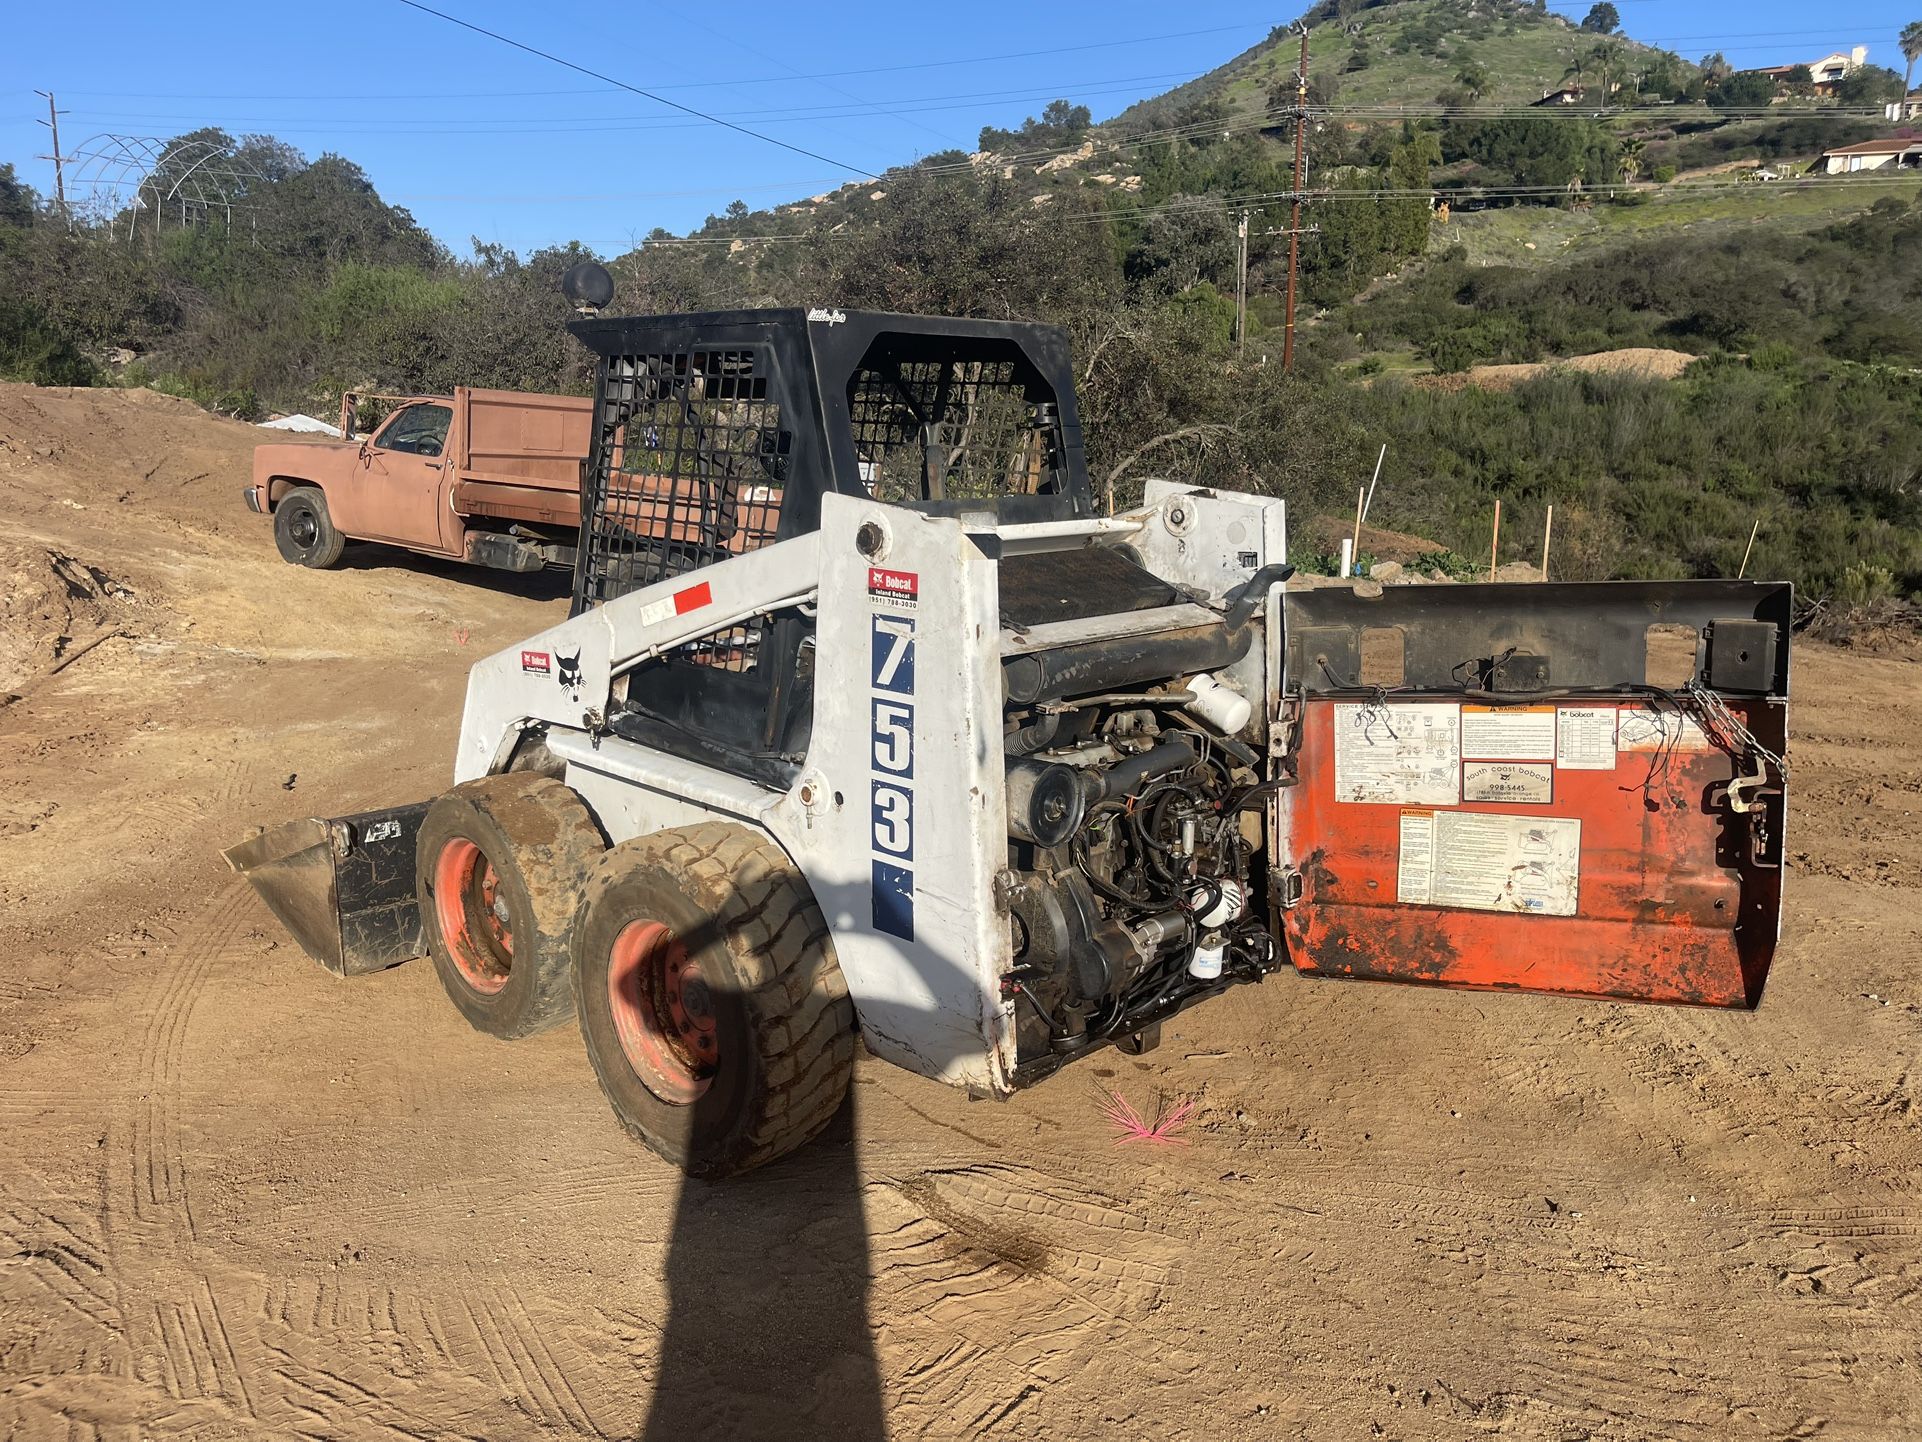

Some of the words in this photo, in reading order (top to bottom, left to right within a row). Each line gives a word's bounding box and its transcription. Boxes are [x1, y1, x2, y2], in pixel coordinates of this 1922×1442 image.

[885, 575, 913, 591] Bobcat
[869, 596, 885, 605] (951)
[875, 589, 891, 597] Inland
[892, 590, 911, 599] Bobcat
[1466, 767, 1488, 781] south
[1518, 767, 1550, 784] bobcat
